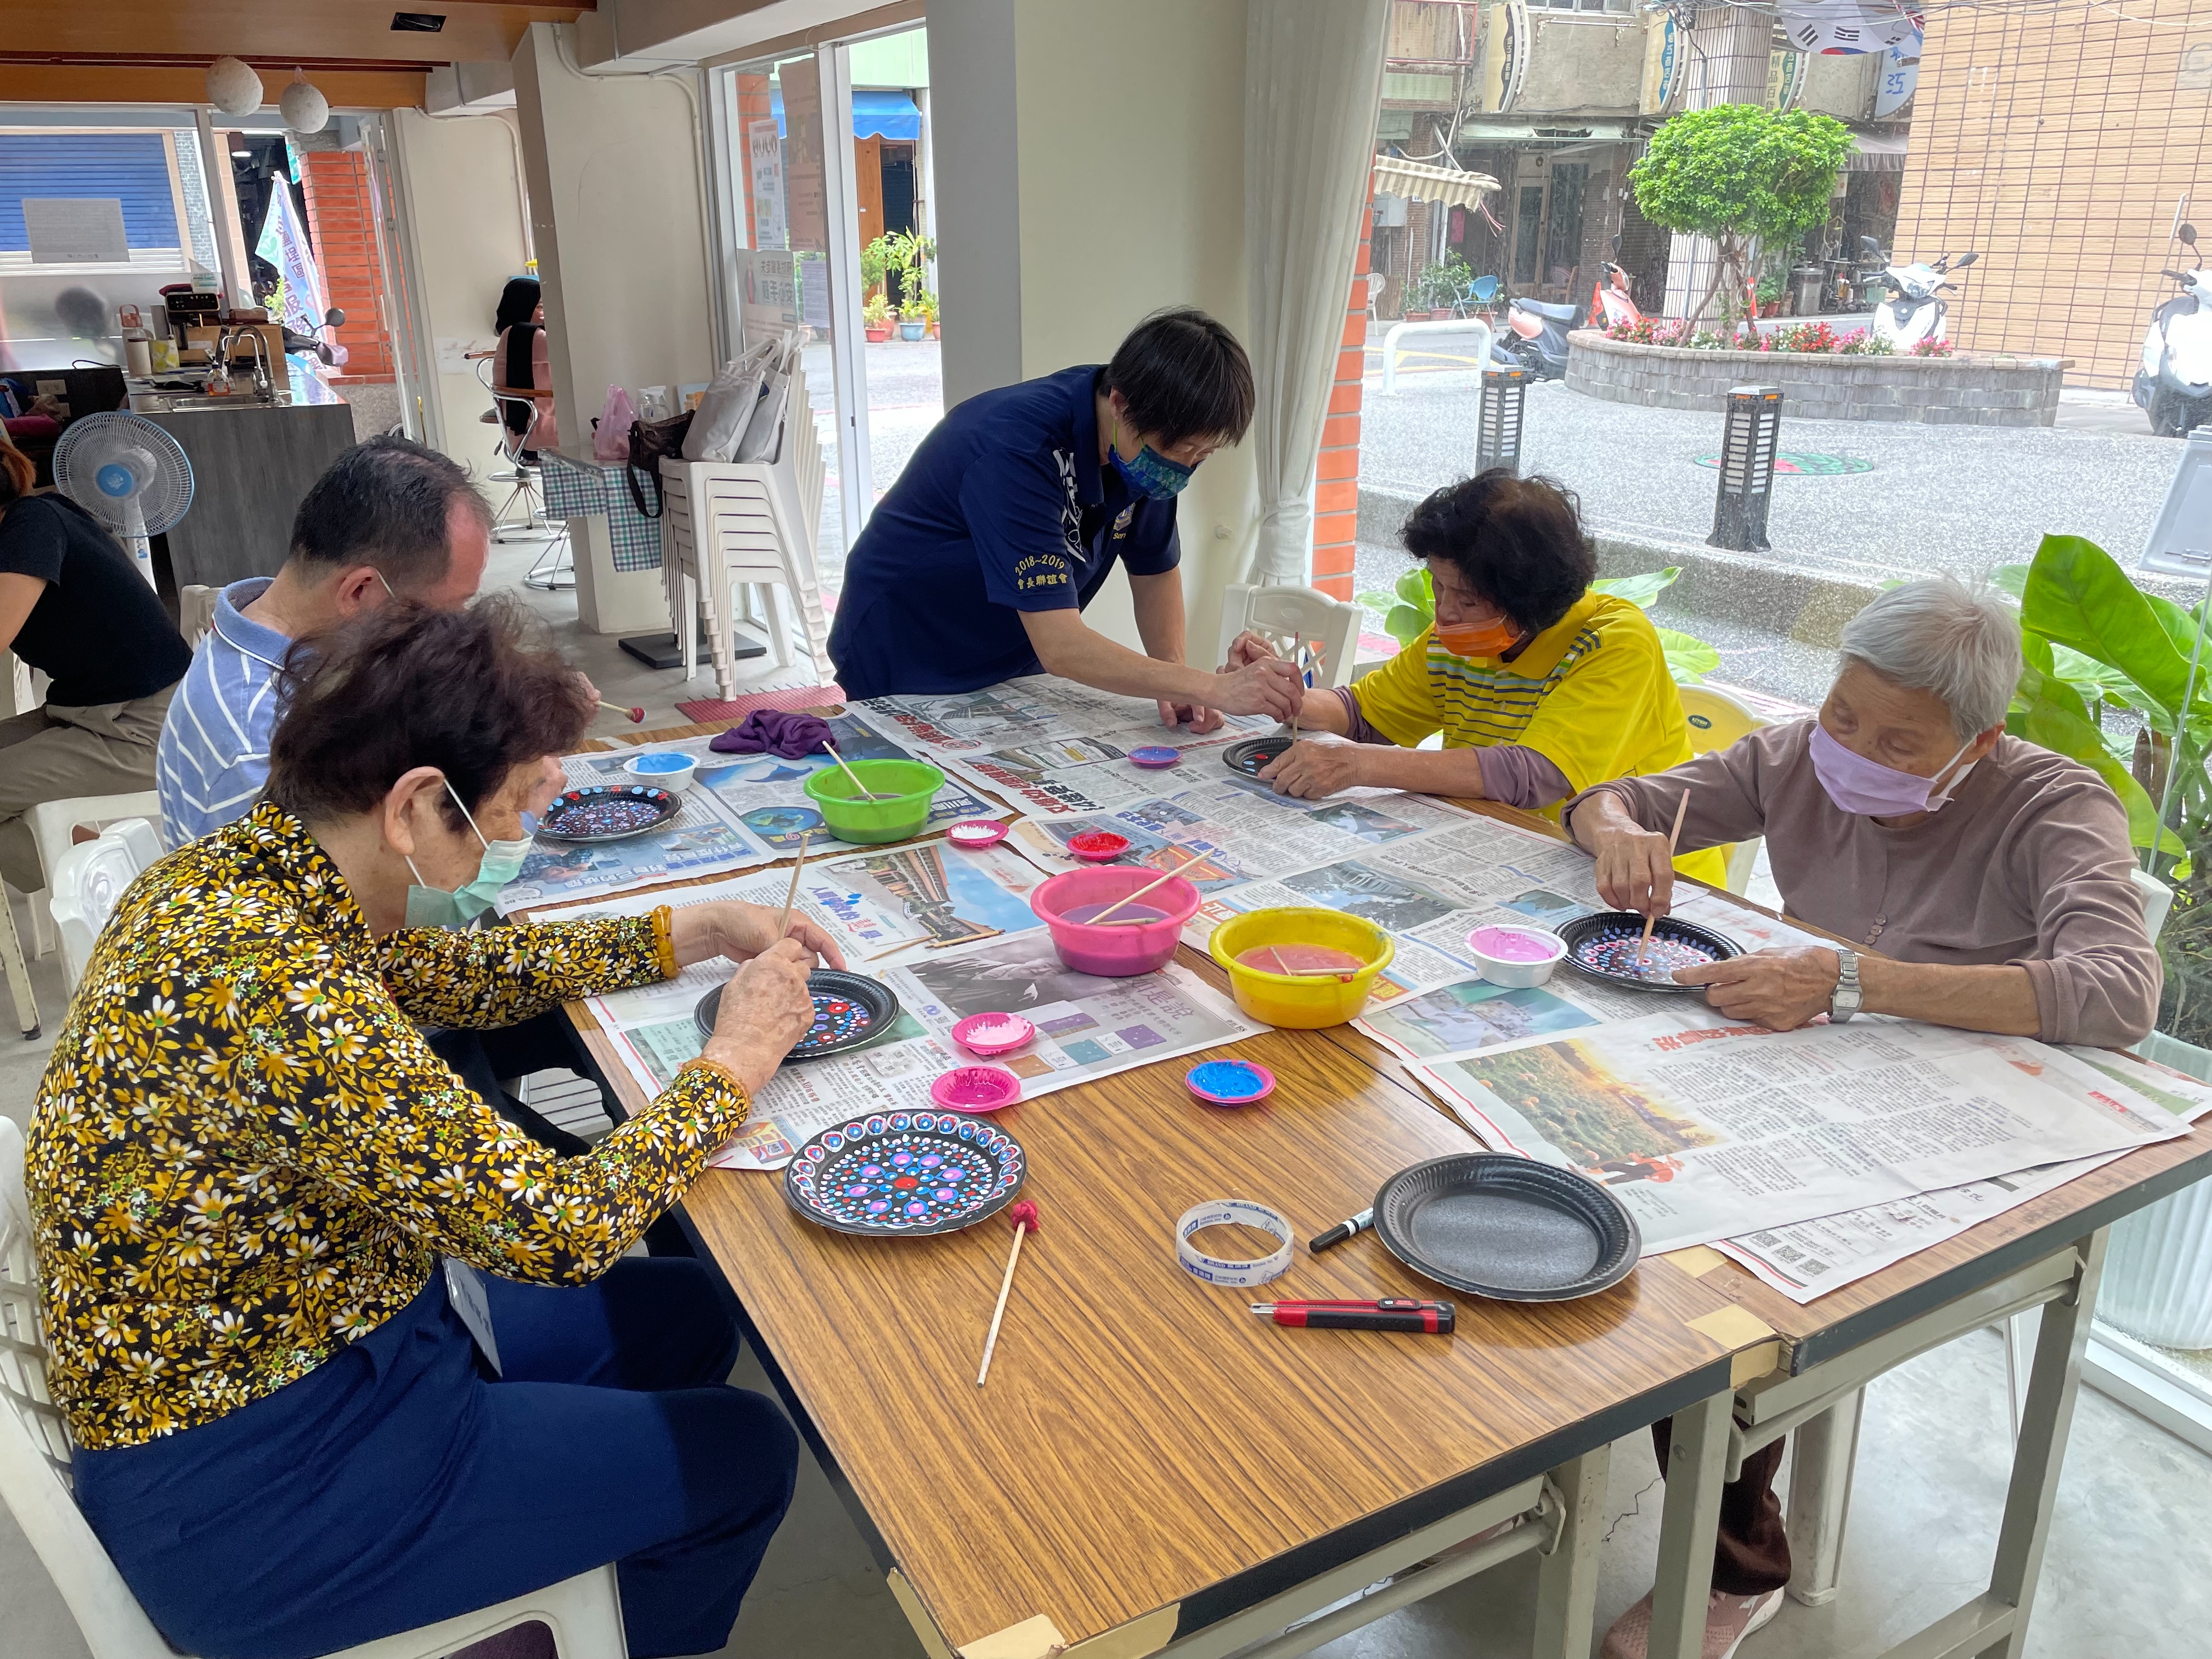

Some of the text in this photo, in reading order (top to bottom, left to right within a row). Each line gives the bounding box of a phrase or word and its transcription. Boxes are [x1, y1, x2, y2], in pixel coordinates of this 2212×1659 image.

[1015, 554, 1065, 577] 2018~2019
[1017, 573, 1068, 590] 會長聯誼會
